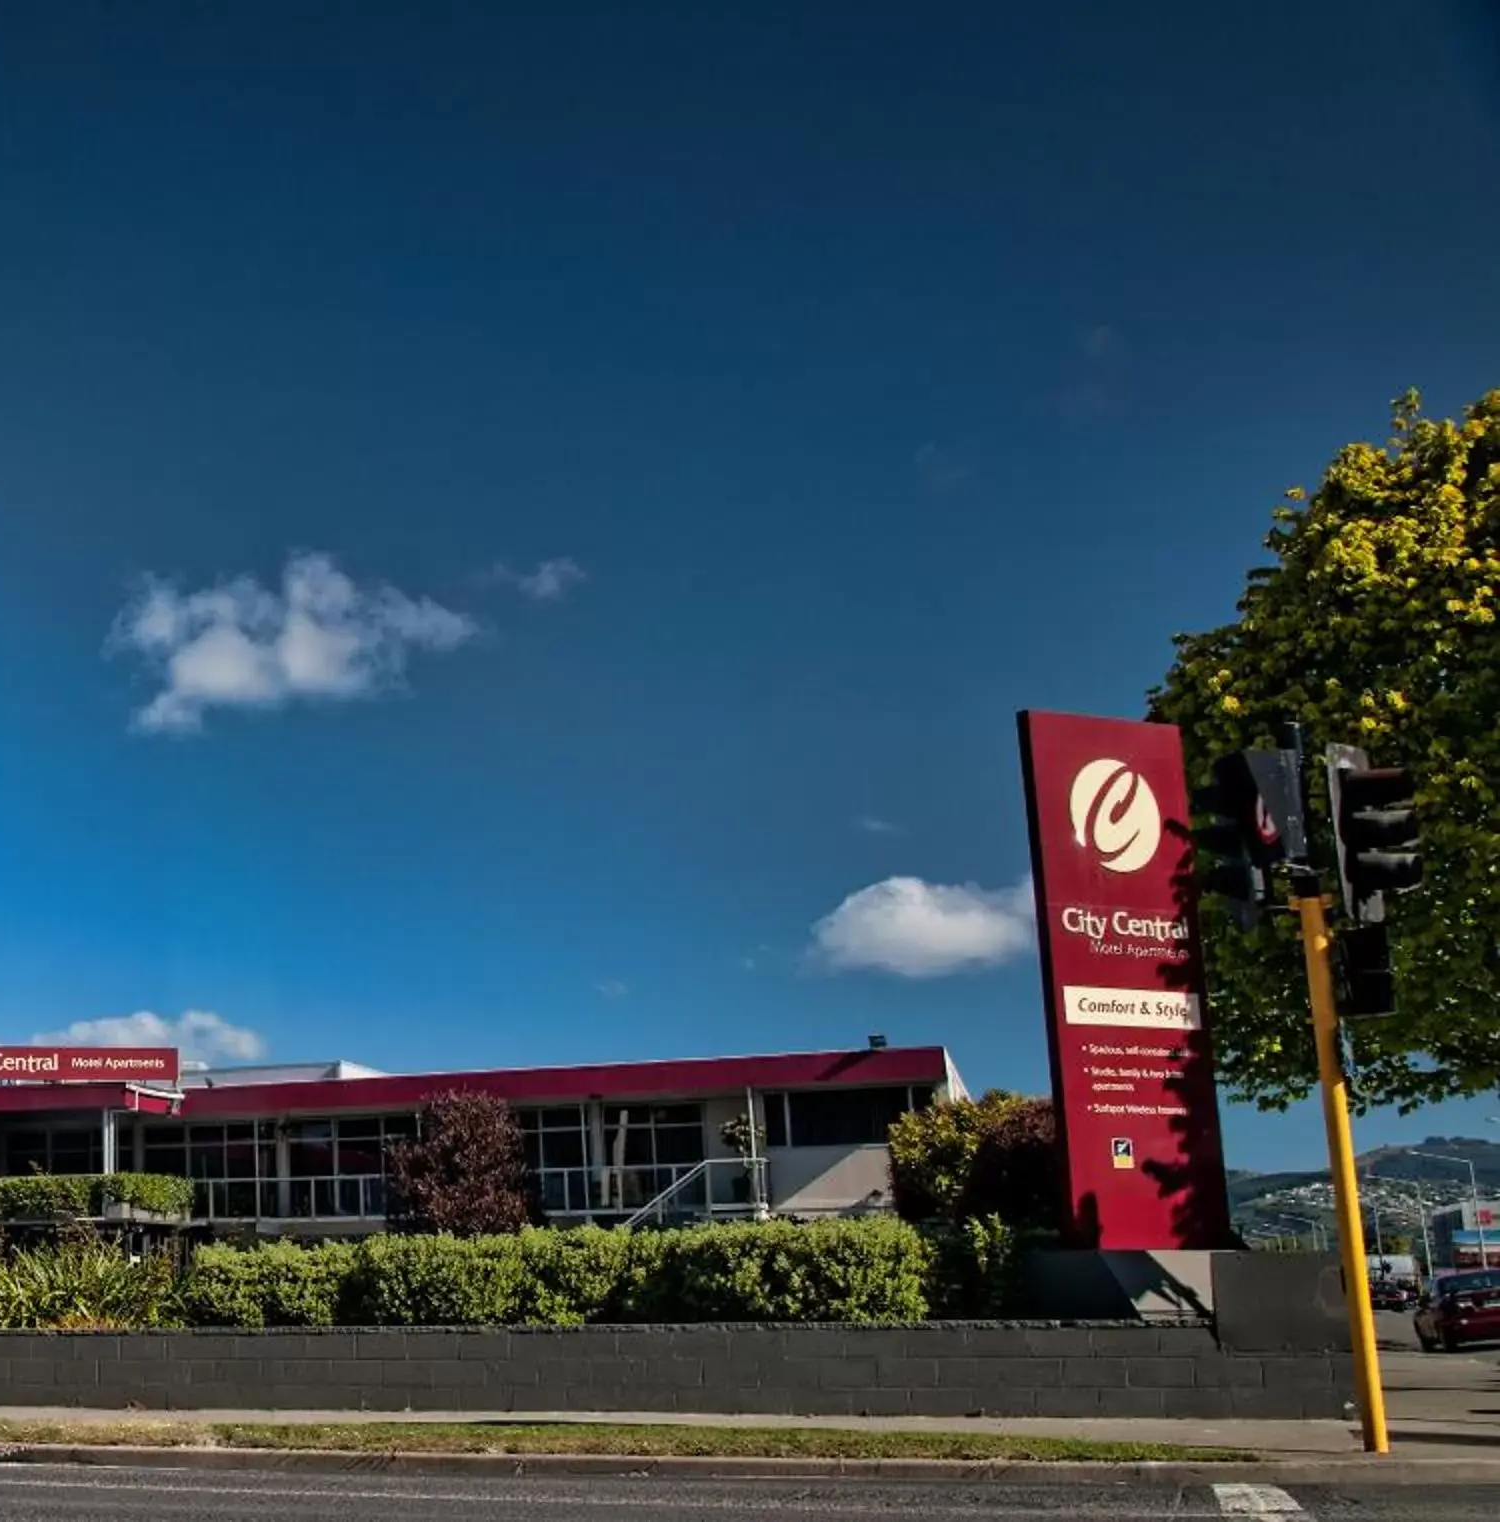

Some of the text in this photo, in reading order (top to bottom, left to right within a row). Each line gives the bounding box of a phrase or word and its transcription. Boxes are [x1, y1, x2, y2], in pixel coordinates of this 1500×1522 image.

[1062, 907, 1189, 942] City Central
[1078, 997, 1136, 1014] Comfort
[1139, 1001, 1151, 1015] &
[71, 1057, 102, 1069] Motel
[104, 1057, 165, 1070] Apartments
